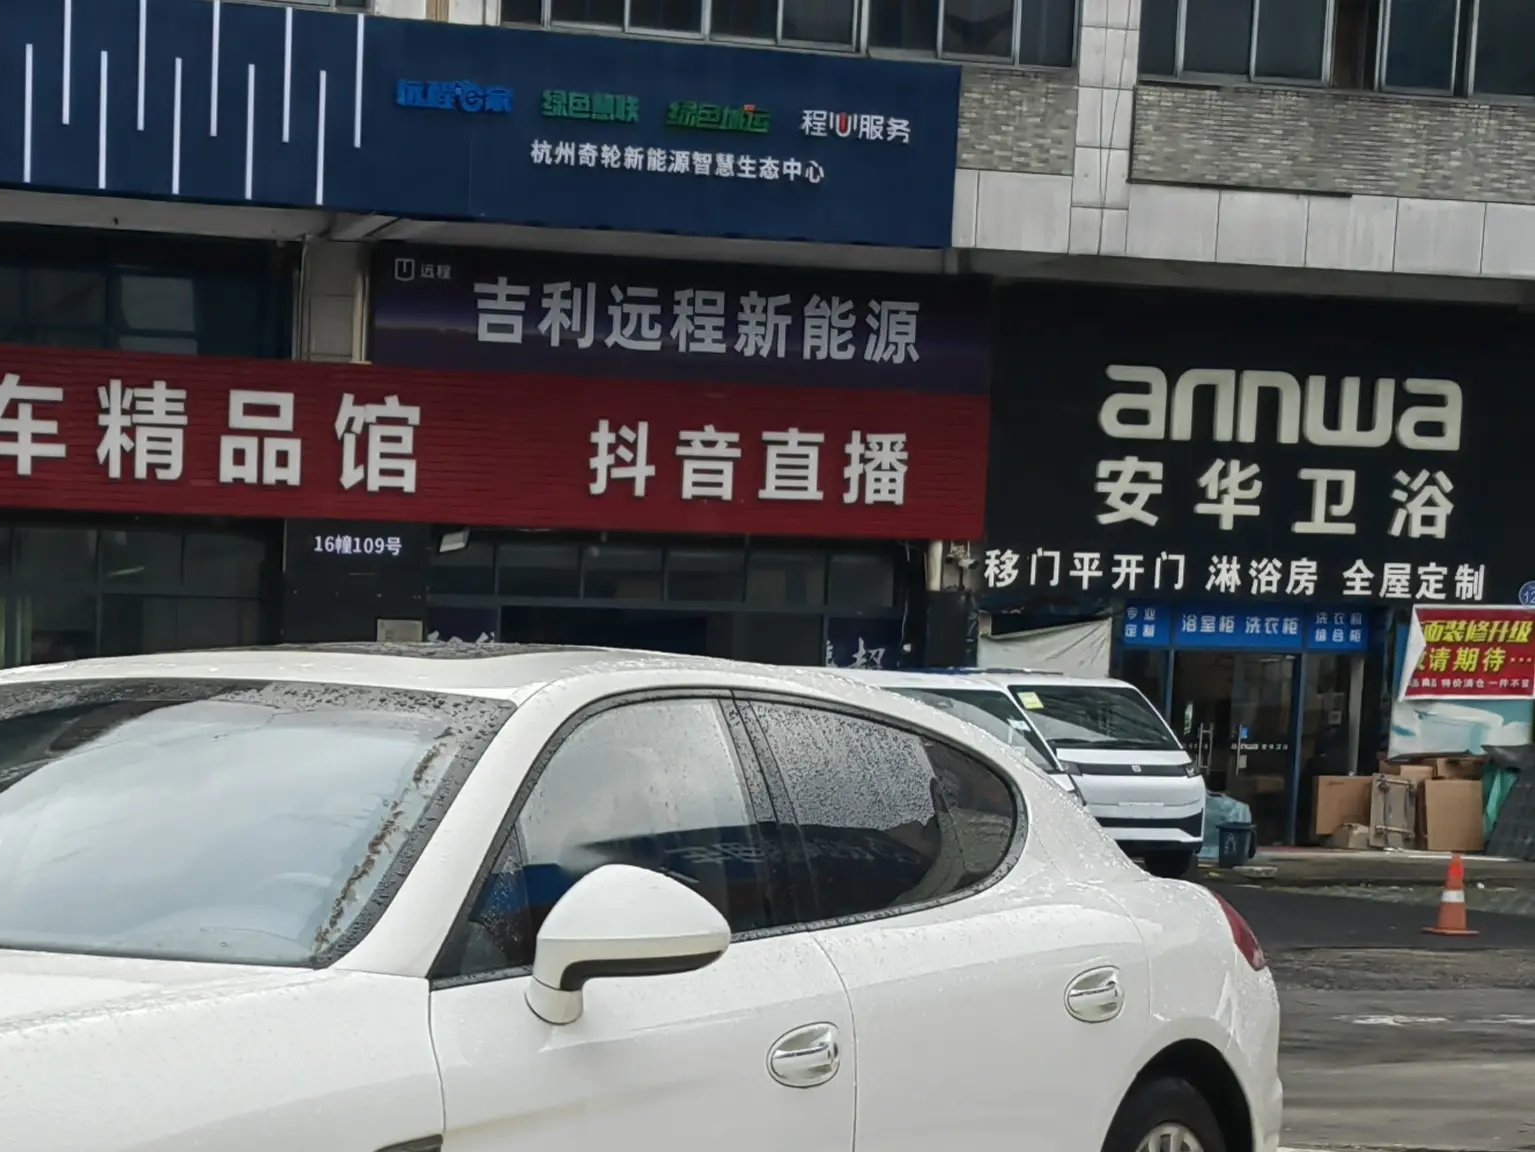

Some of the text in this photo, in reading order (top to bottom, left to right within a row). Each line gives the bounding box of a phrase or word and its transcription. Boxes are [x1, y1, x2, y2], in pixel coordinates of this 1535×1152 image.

[531, 140, 825, 184] 杭州奇轮新能源智慧生态中心
[473, 276, 921, 364] 吉利远程新能源
[1097, 364, 1463, 451] annwa
[589, 419, 909, 506] 抖音直播
[1095, 456, 1456, 539] 安华卫浴
[314, 534, 402, 556] 16幢109号
[984, 548, 1486, 601] 移门平开门 淋浴房 全屋定制
[1182, 614, 1299, 635] 浴室柜 洗衣柜
